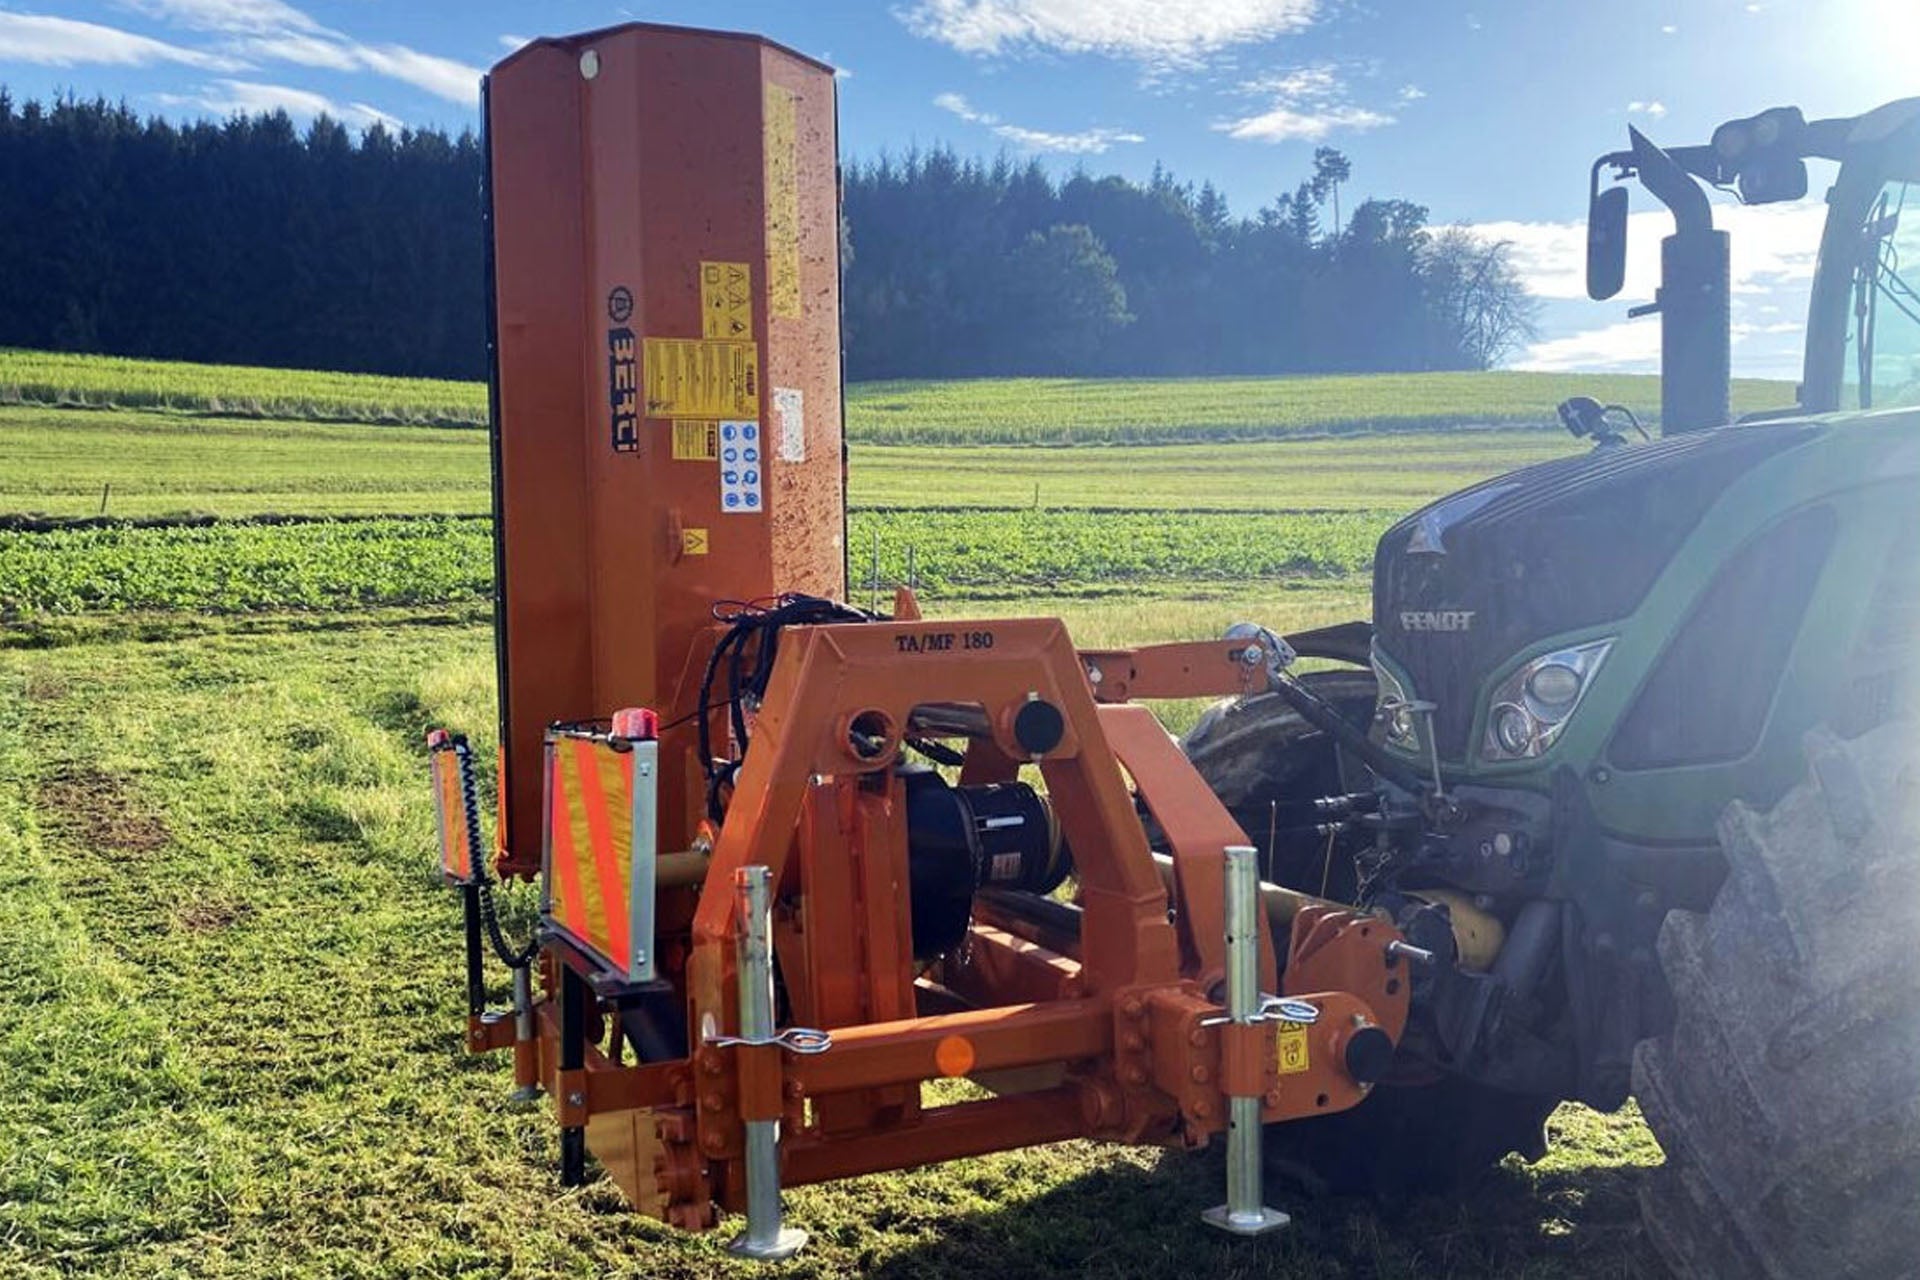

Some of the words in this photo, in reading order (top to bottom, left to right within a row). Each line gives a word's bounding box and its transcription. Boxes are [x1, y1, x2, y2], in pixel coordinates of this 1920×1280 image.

[1400, 611, 1476, 631] FENDT
[895, 633, 955, 653] TA/MF
[963, 632, 994, 649] 180
